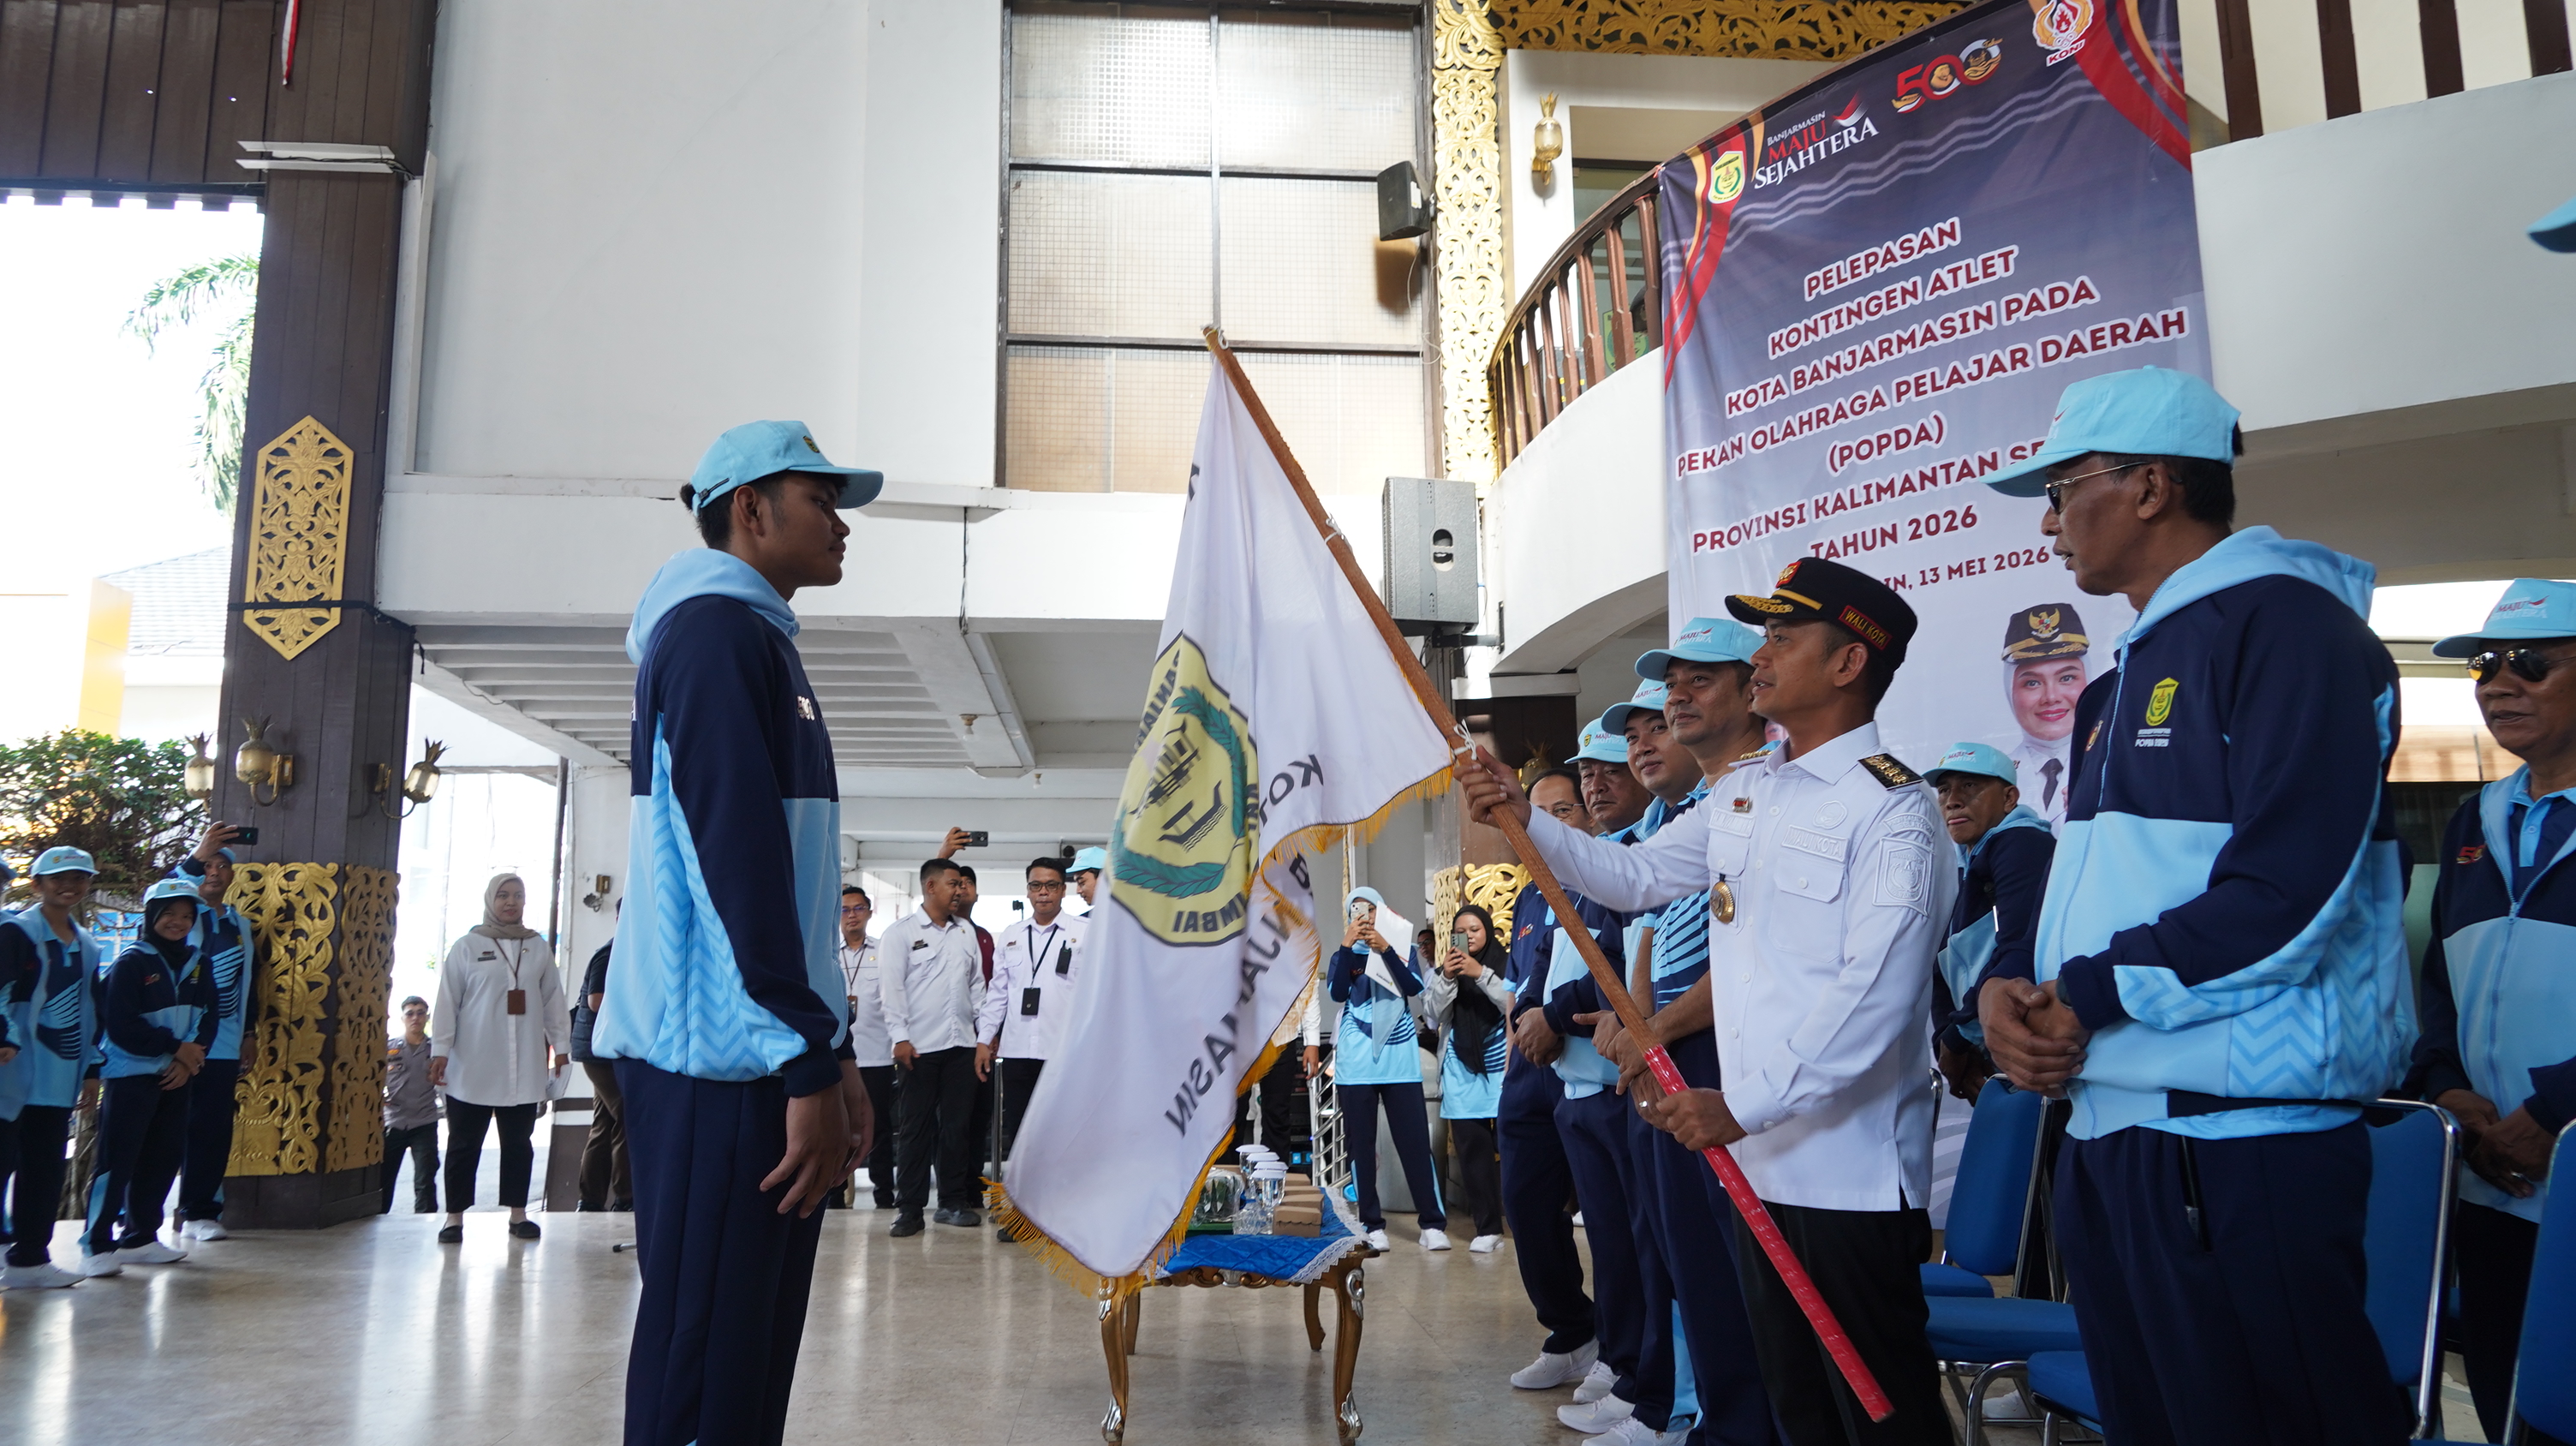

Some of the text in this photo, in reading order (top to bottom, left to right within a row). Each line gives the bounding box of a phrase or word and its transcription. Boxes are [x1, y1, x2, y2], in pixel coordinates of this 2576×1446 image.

[2048, 41, 2084, 64] KONI
[1754, 117, 1879, 189] SEJAHTERA
[1767, 111, 1826, 146] BANJARMASIN
[1768, 120, 1827, 164] MAJU
[1806, 221, 1958, 298] PELEPASAN
[1770, 249, 2015, 356] KONTINGEN ATLET
[1727, 280, 2096, 415] KOTA BANJARMASIN PADA
[1678, 310, 2185, 478] PEKAN OLAHRAGA PELAJAR DAERAH
[1828, 414, 1945, 473] (POPDA)
[1693, 503, 1807, 553] PROVINSI
[1814, 451, 1999, 519] KALIMANTAN
[1810, 505, 1978, 560] TAHUN 2026
[1919, 566, 1941, 586] 13
[1947, 557, 1987, 581] MEI
[1994, 546, 2050, 571] 2026
[1845, 609, 1887, 647] WALI KOTA
